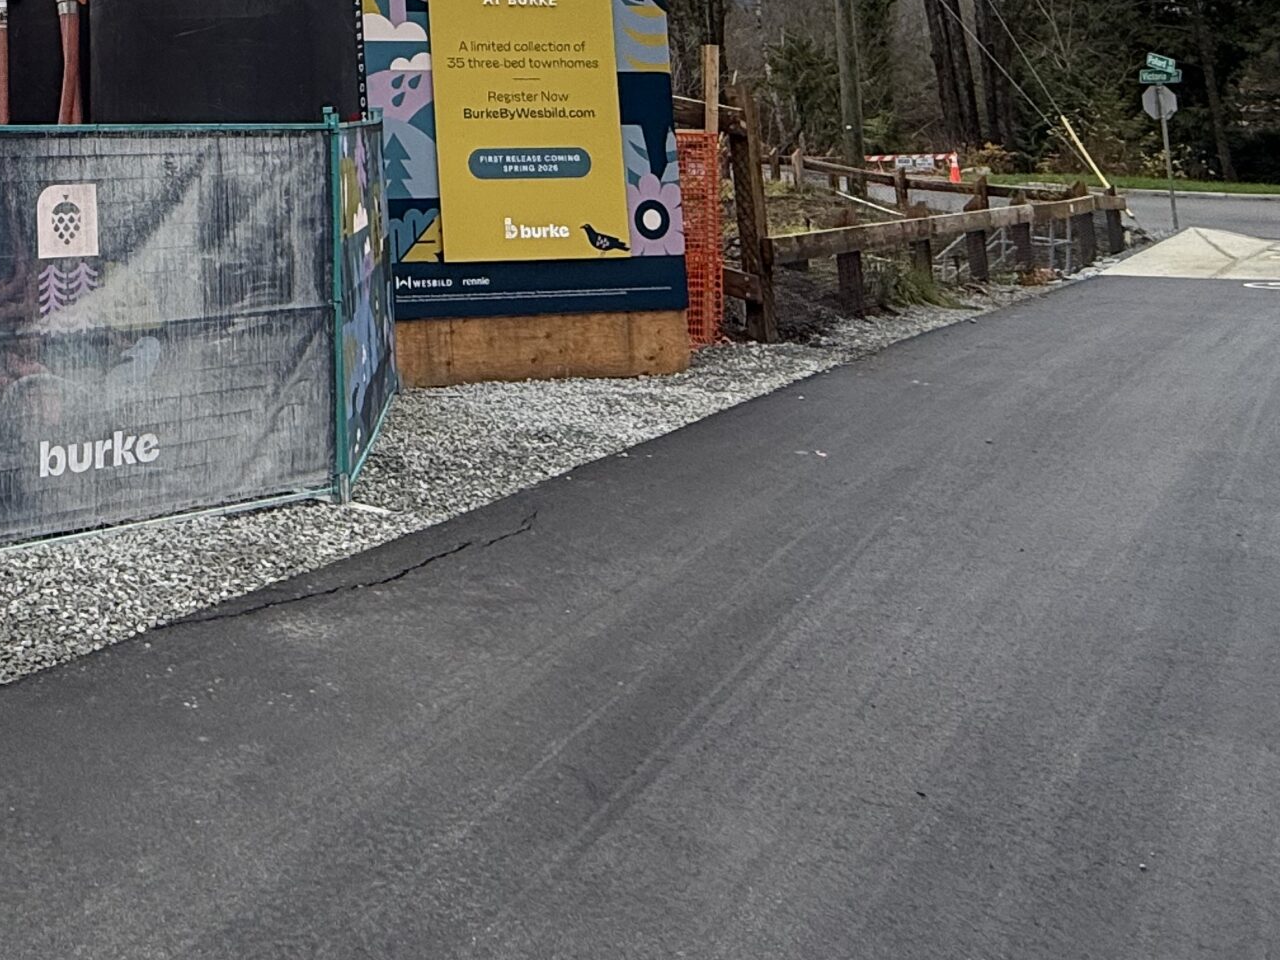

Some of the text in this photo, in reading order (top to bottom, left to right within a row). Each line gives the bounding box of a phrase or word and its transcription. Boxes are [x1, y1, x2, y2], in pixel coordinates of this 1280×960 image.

[458, 41, 586, 52] A limited collection of
[447, 57, 599, 69] 35 three-bed townhomes
[487, 91, 569, 104] Register Now
[463, 108, 596, 120] BurkeByWesbild.com
[479, 154, 581, 163] FIRST RELEASE COMING
[503, 164, 559, 172] SPRING 2026
[520, 224, 570, 239] burke
[412, 277, 490, 287] WESBILD rennie
[39, 430, 161, 478] burke
